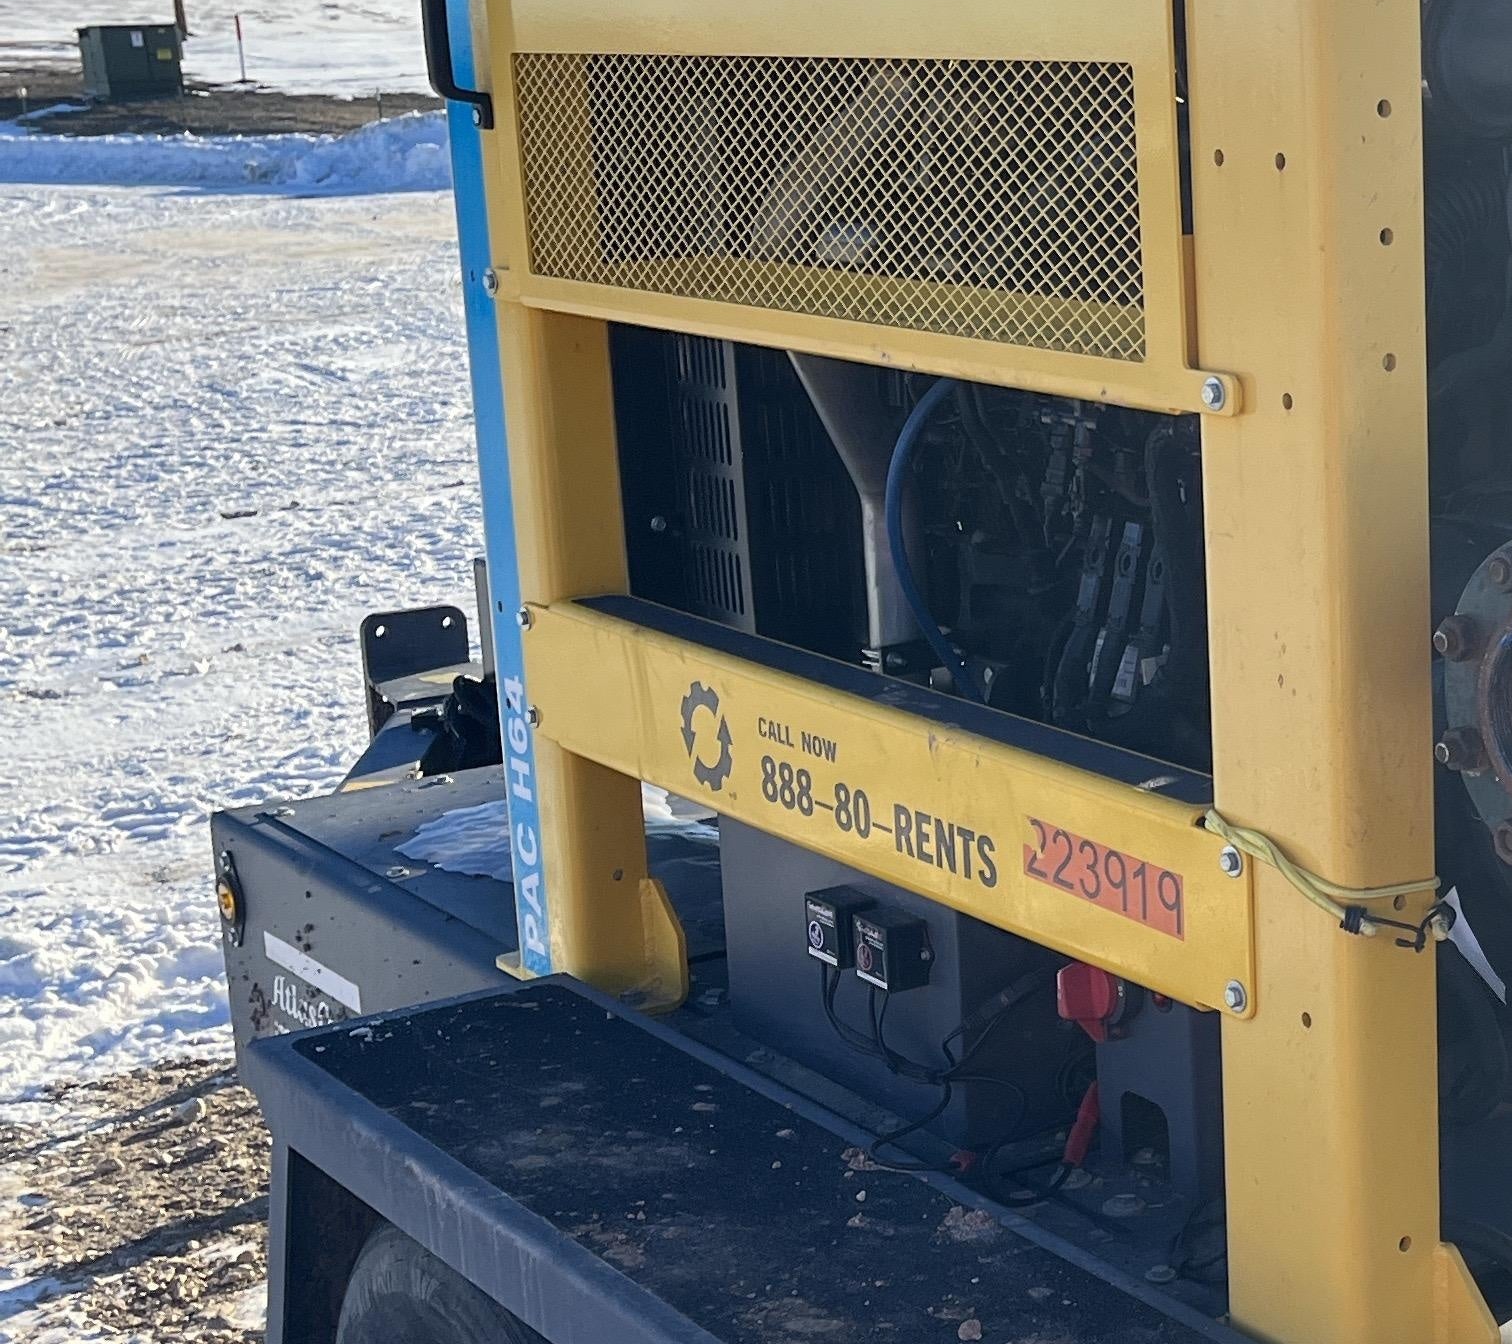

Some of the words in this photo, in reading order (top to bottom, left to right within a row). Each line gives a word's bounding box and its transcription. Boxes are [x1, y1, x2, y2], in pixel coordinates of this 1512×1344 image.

[503, 674, 534, 802] H64
[757, 715, 795, 749] CALL
[800, 728, 838, 764] NOW
[760, 754, 999, 889] 888-80-RENTS
[1025, 817, 1184, 937] 223919
[516, 824, 547, 957] PAC
